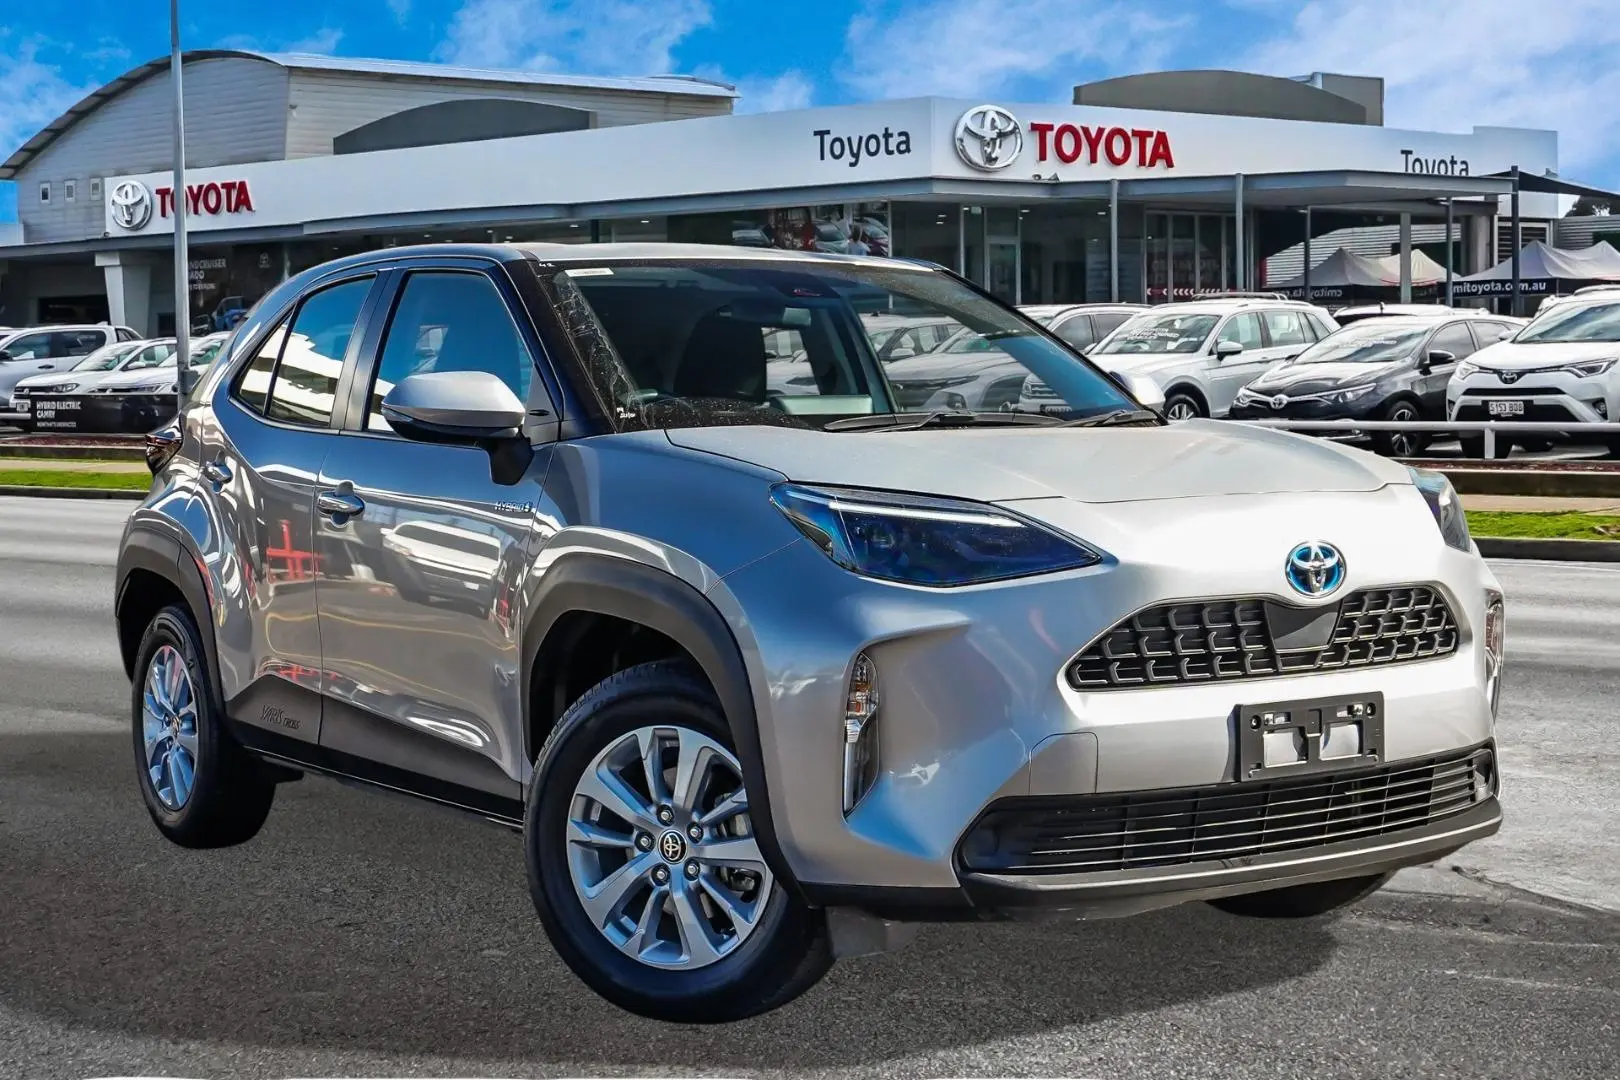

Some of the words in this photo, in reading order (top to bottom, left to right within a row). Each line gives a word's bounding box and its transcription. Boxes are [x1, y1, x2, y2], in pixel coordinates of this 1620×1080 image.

[813, 127, 911, 167] Toyota
[1030, 122, 1175, 168] TOYOTA
[1452, 281, 1546, 295] mitoyota.cm.au
[261, 705, 284, 723] YARIS
